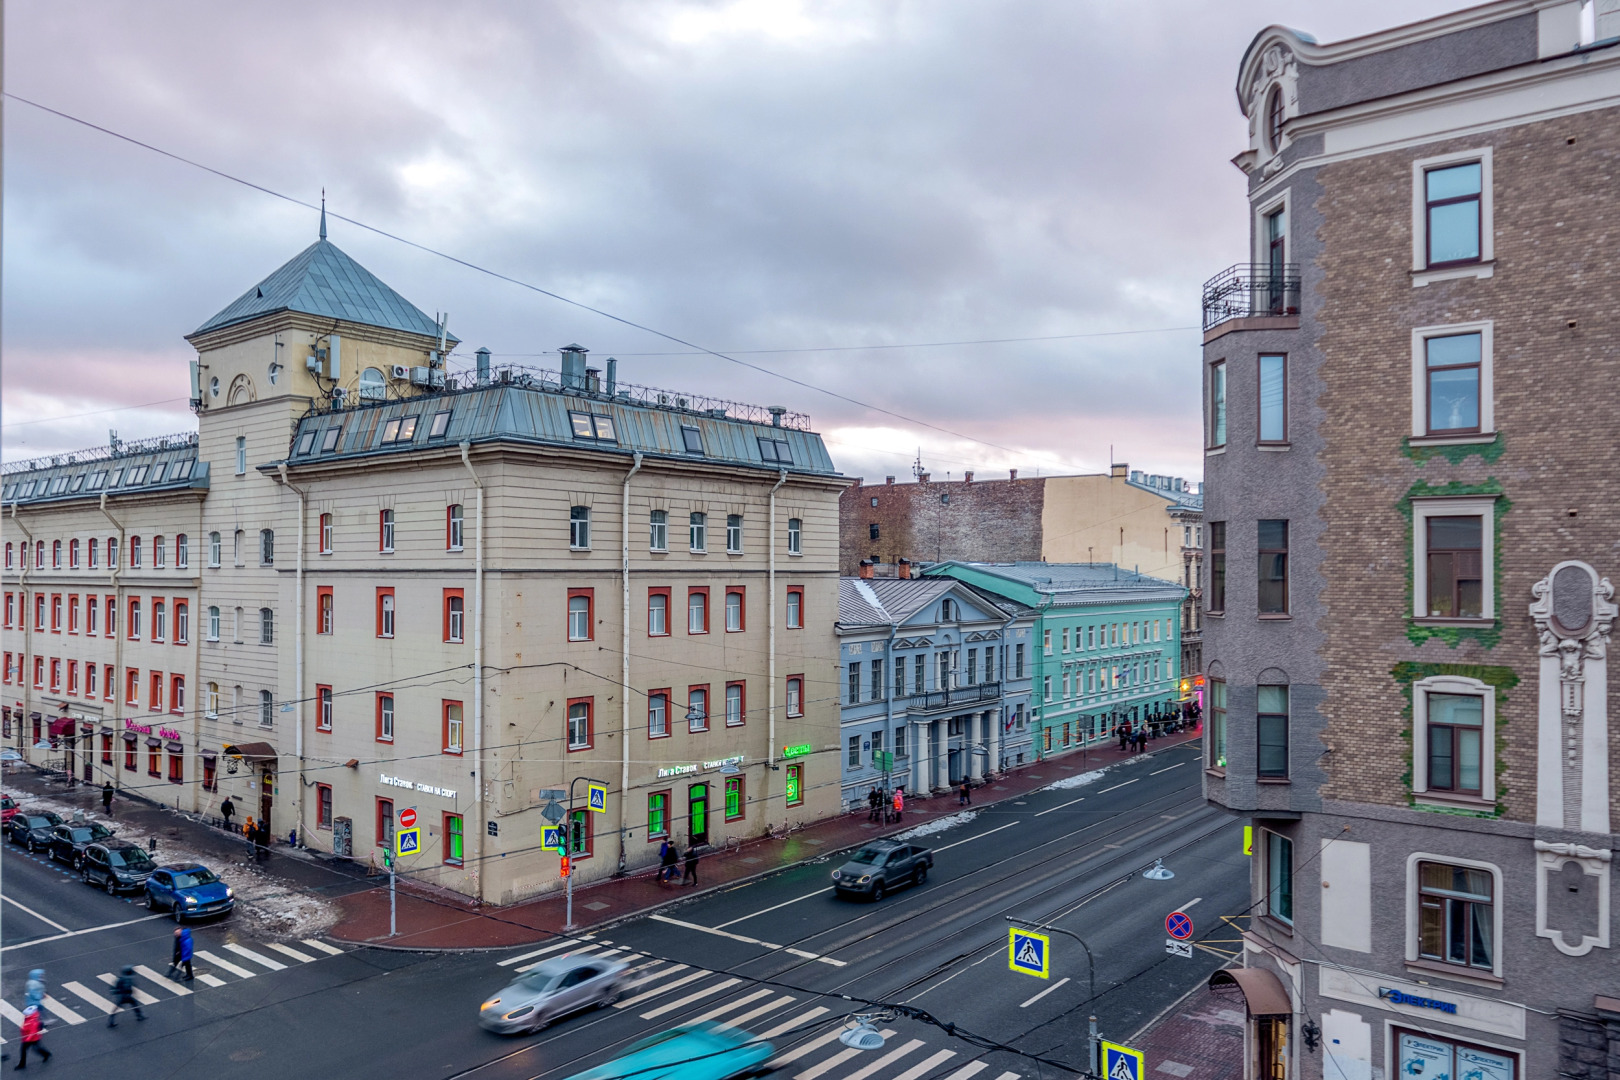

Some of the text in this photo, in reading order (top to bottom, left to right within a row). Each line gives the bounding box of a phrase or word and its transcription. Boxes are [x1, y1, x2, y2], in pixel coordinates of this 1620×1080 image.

[657, 766, 675, 779] Лига
[675, 763, 698, 775] Ставок
[380, 773, 394, 786] Лига
[393, 776, 414, 790] Ставок
[441, 787, 457, 799] СПОРТ
[1389, 989, 1457, 1014] ЭЛЕКТРИК
[1413, 1040, 1444, 1053] ЭЛЕКТРИК
